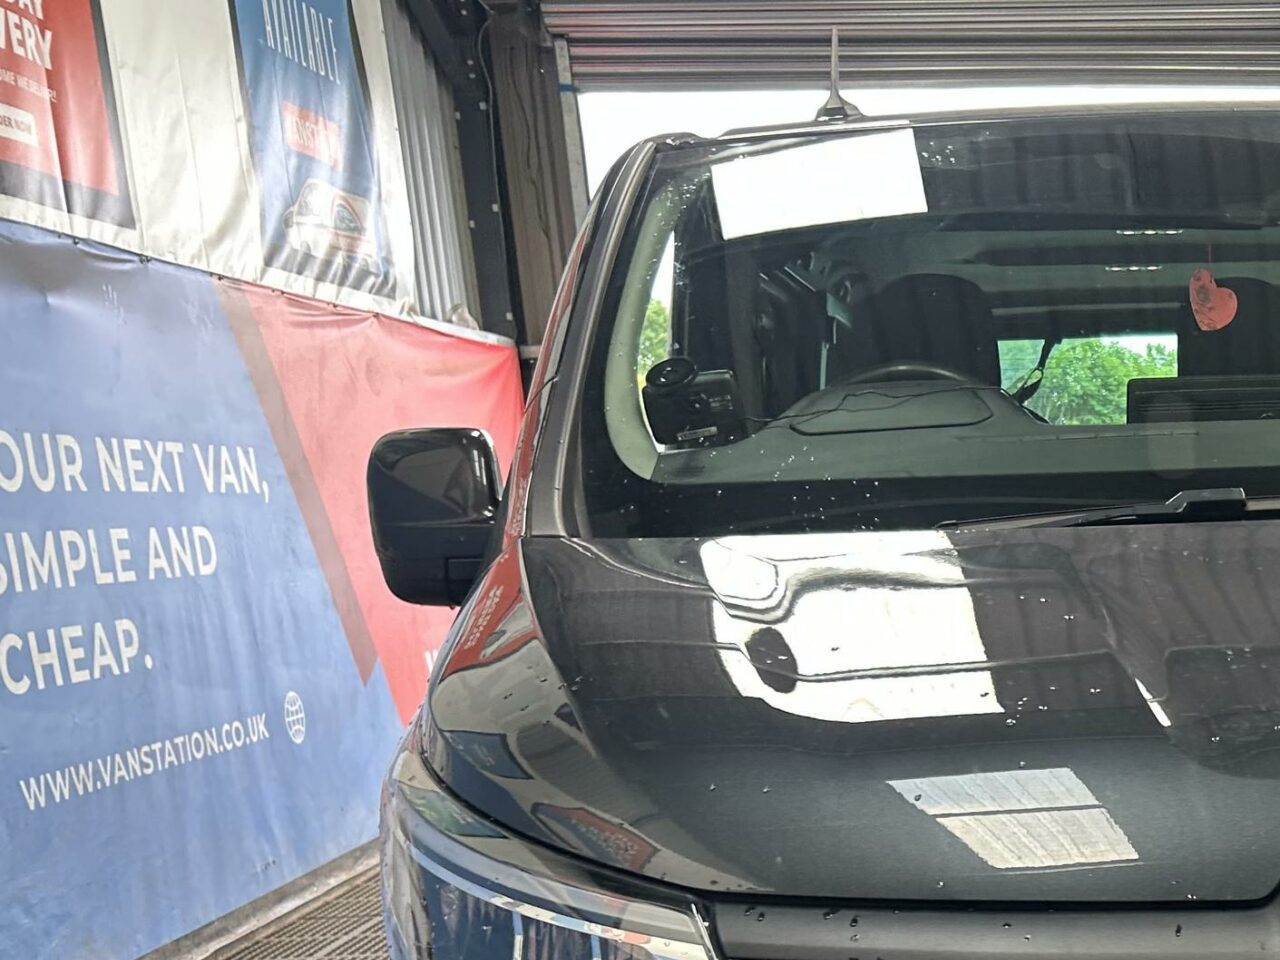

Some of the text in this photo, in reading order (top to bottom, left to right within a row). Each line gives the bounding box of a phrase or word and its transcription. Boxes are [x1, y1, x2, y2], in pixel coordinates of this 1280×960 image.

[95, 437, 184, 493] NEXT
[192, 443, 269, 503] VAN,
[149, 526, 218, 580] AND
[0, 618, 153, 695] CHEAP.
[20, 713, 269, 811] WWW.VANSTATION.CO.UK
